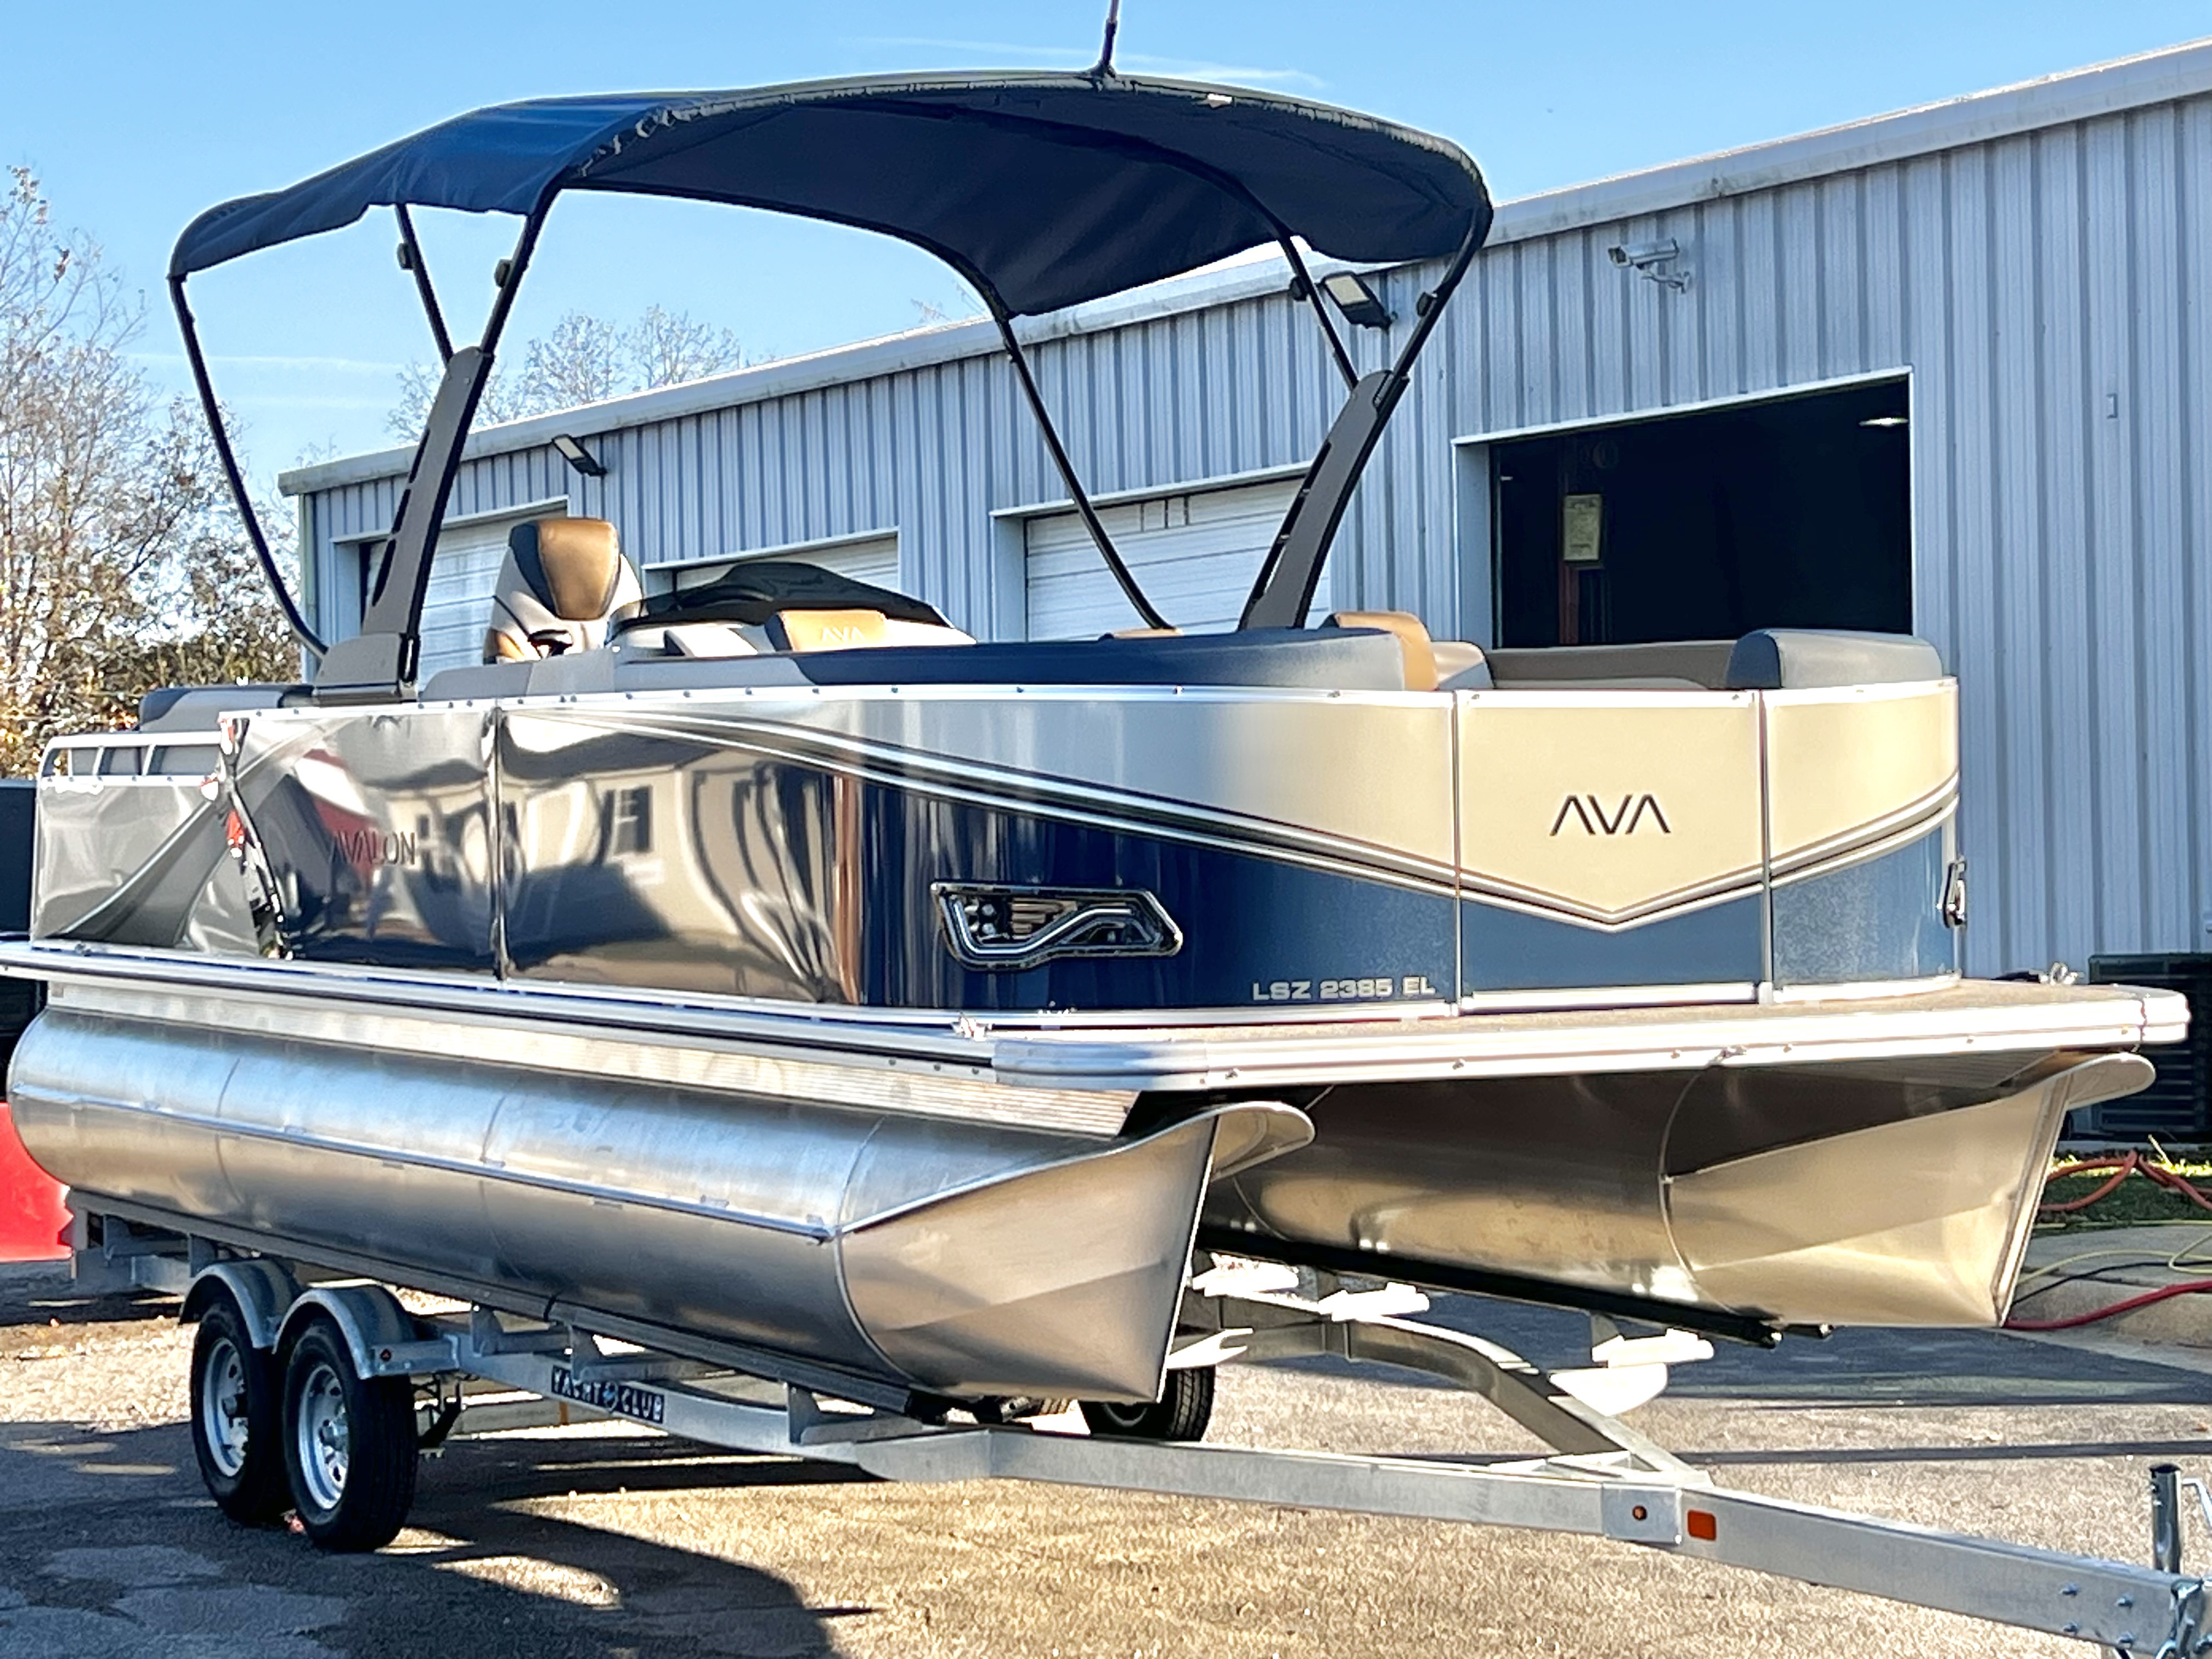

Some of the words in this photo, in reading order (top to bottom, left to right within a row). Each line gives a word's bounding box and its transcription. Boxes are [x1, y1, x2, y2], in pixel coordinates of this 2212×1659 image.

[1549, 794, 1671, 836] AVA
[331, 830, 415, 865] AVALON
[1252, 980, 1312, 1001] LSZ
[1319, 978, 1393, 999] 2385
[1402, 975, 1436, 996] EL
[621, 1388, 663, 1421] CLUB
